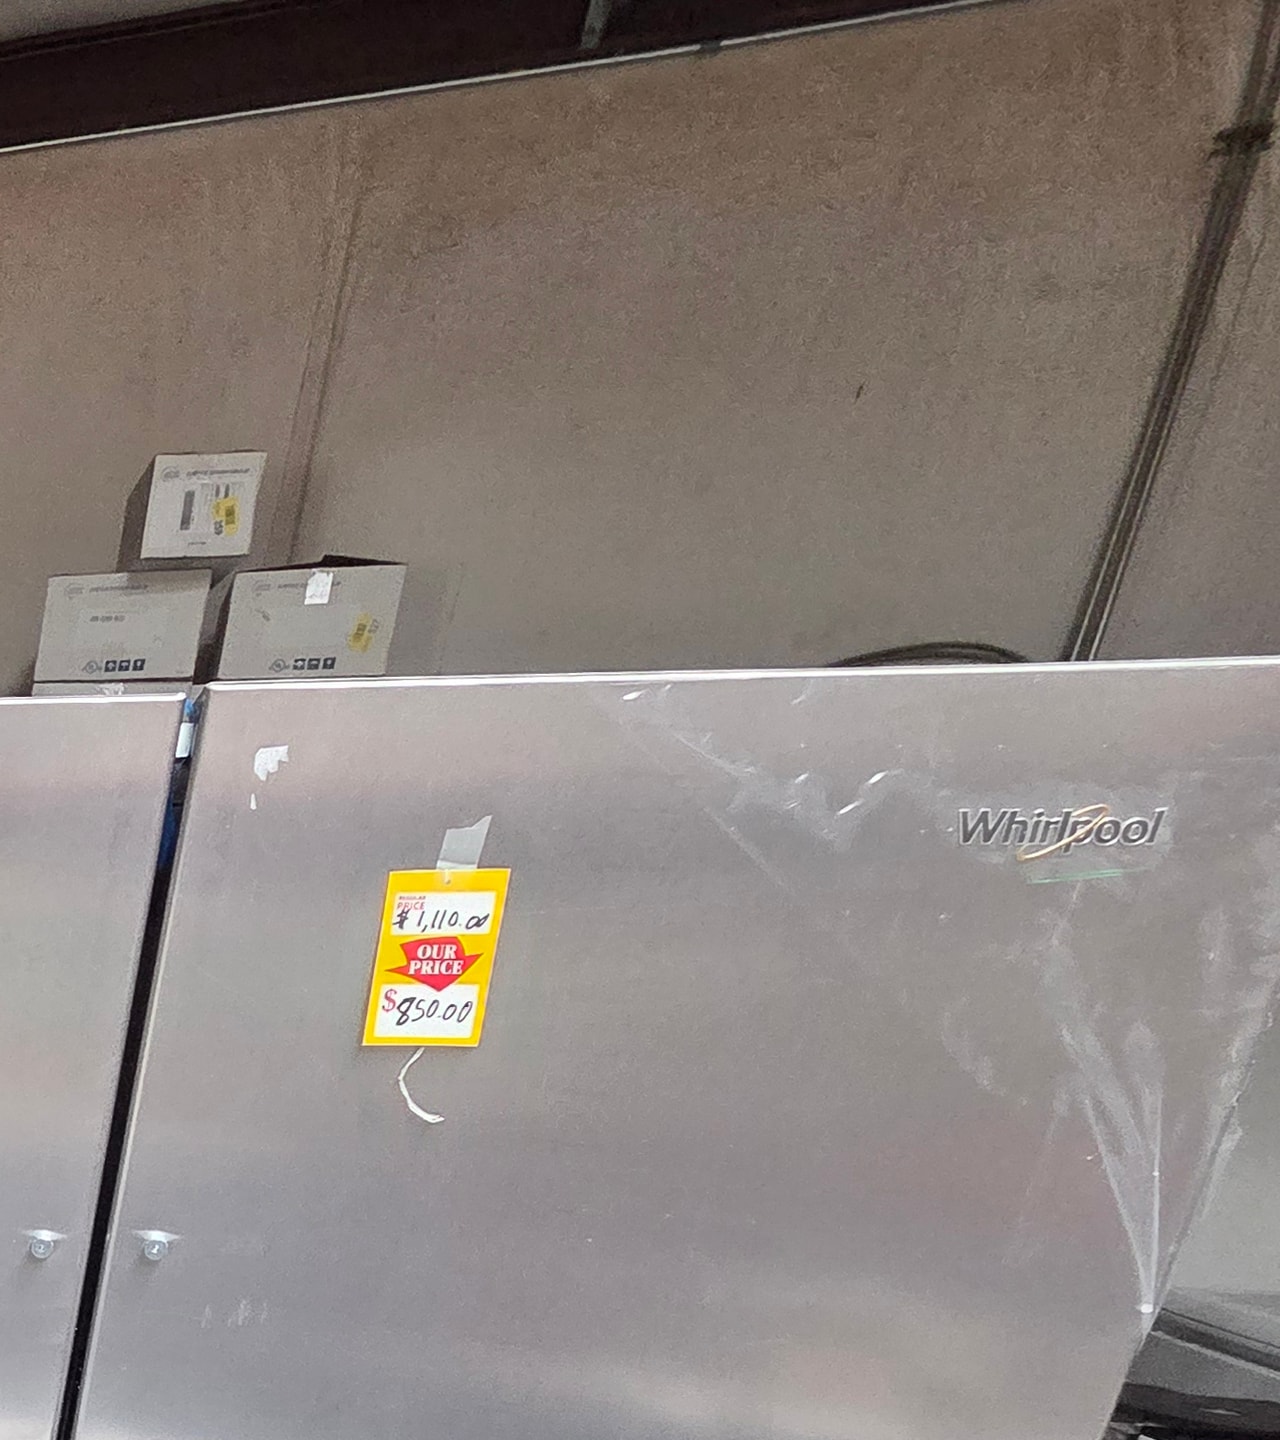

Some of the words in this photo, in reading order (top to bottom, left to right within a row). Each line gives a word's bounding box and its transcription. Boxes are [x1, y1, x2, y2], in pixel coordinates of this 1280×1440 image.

[958, 806, 1170, 854] Whirlpool
[397, 901, 426, 911] PRICE
[416, 944, 458, 960] OUR
[407, 959, 465, 976] PRICE
